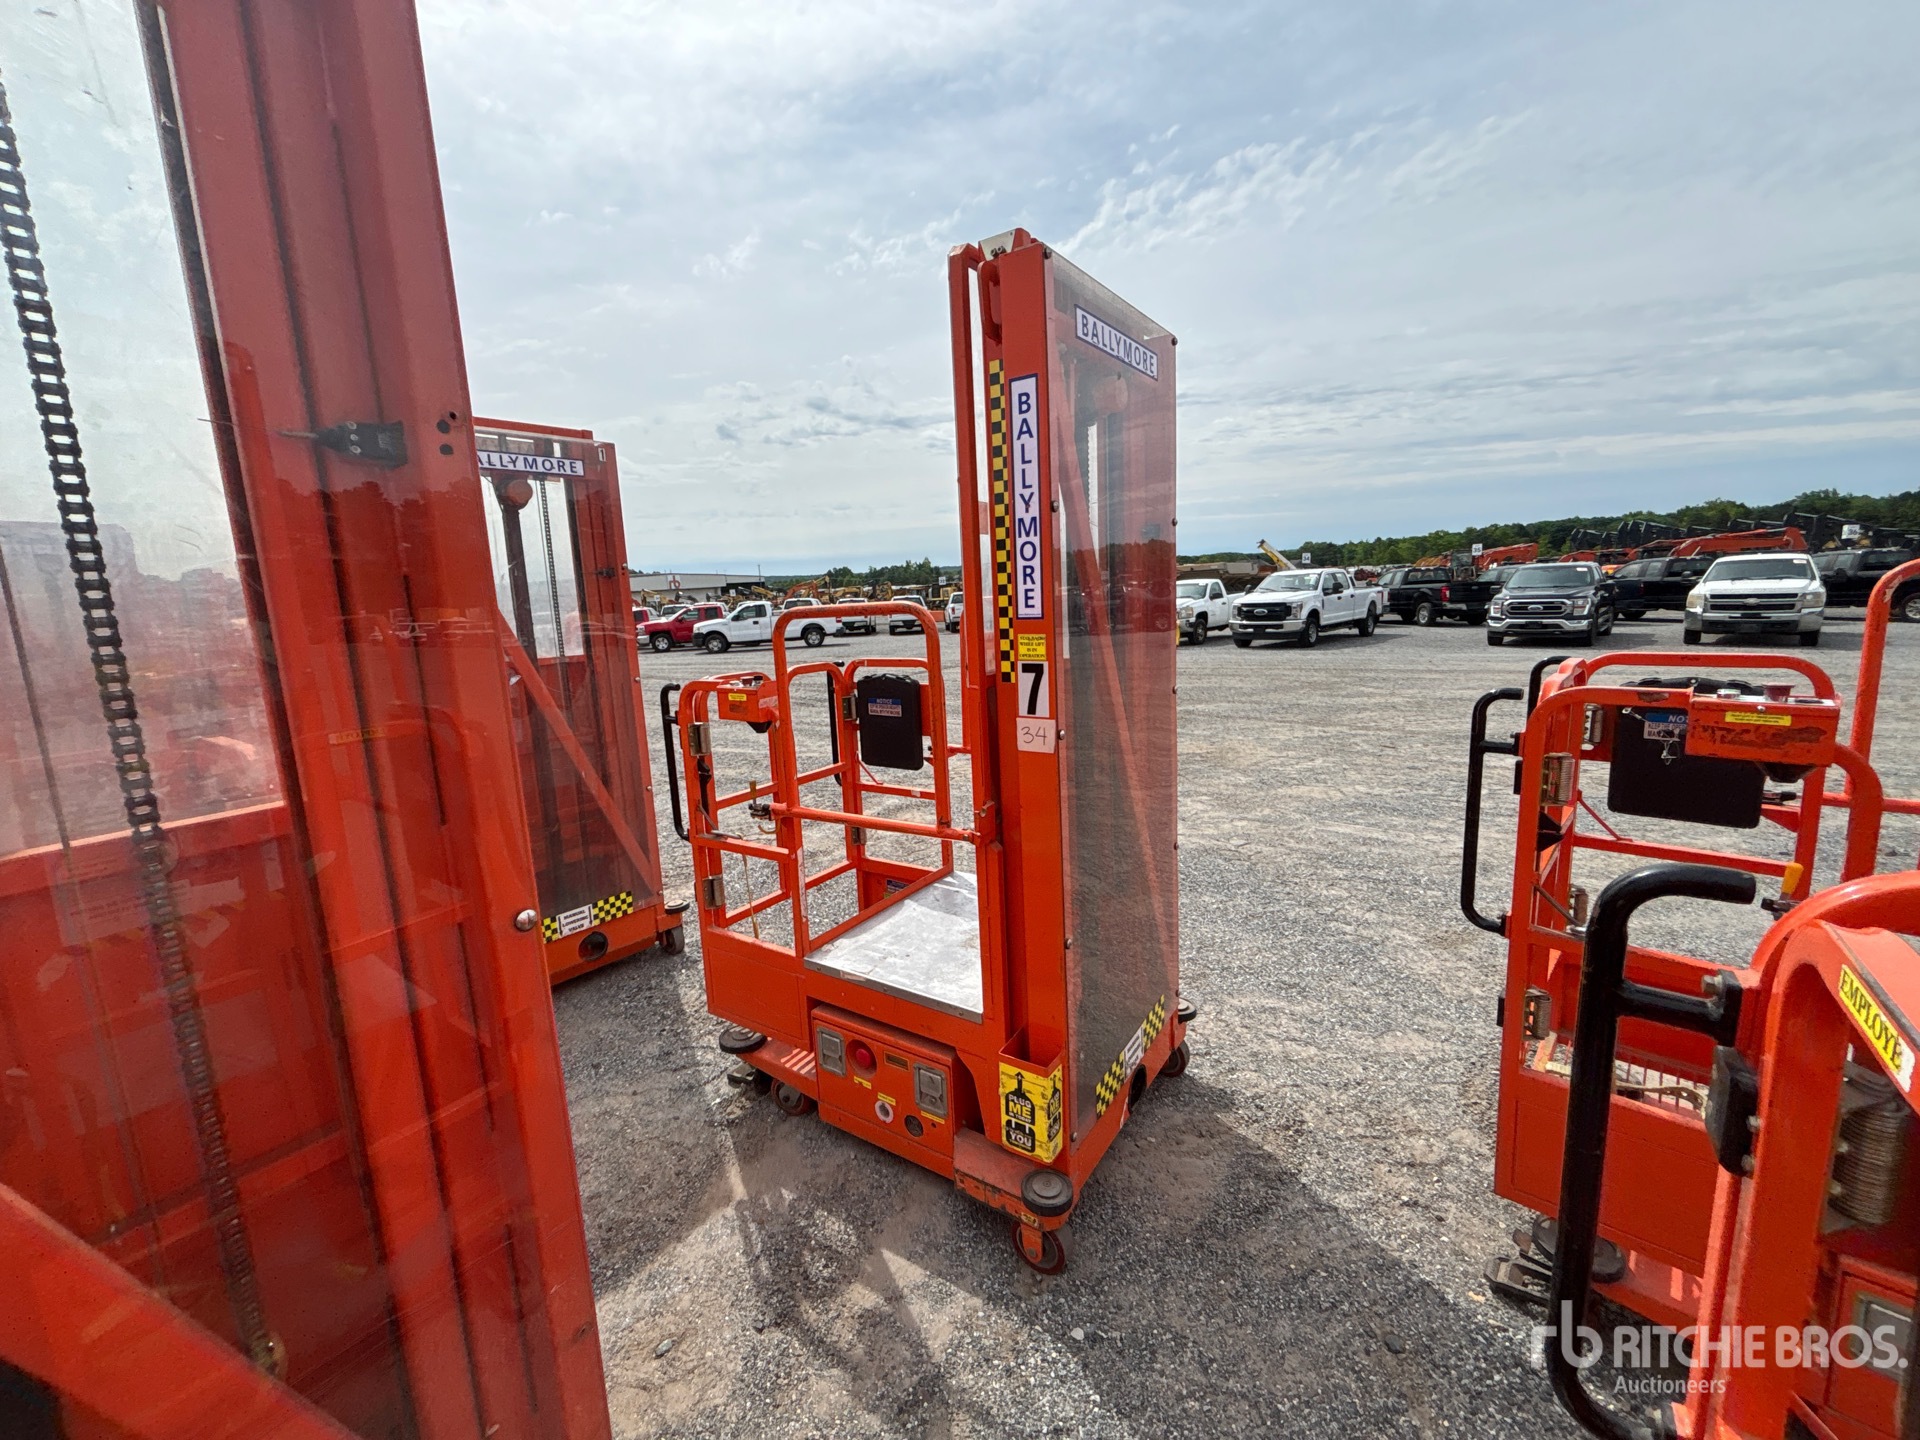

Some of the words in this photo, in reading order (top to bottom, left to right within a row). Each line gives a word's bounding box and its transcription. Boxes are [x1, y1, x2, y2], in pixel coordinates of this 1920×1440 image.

[1081, 313, 1154, 374] BALLYMORE
[477, 453, 578, 474] LLYMORE
[1016, 392, 1038, 608] BALLYMORE
[1021, 663, 1044, 715] 7
[1668, 715, 1689, 723] NO
[1021, 726, 1047, 746] 34
[1009, 1094, 1031, 1108] PLUG
[1009, 1101, 1031, 1119] ME
[1010, 1132, 1031, 1147] YOU
